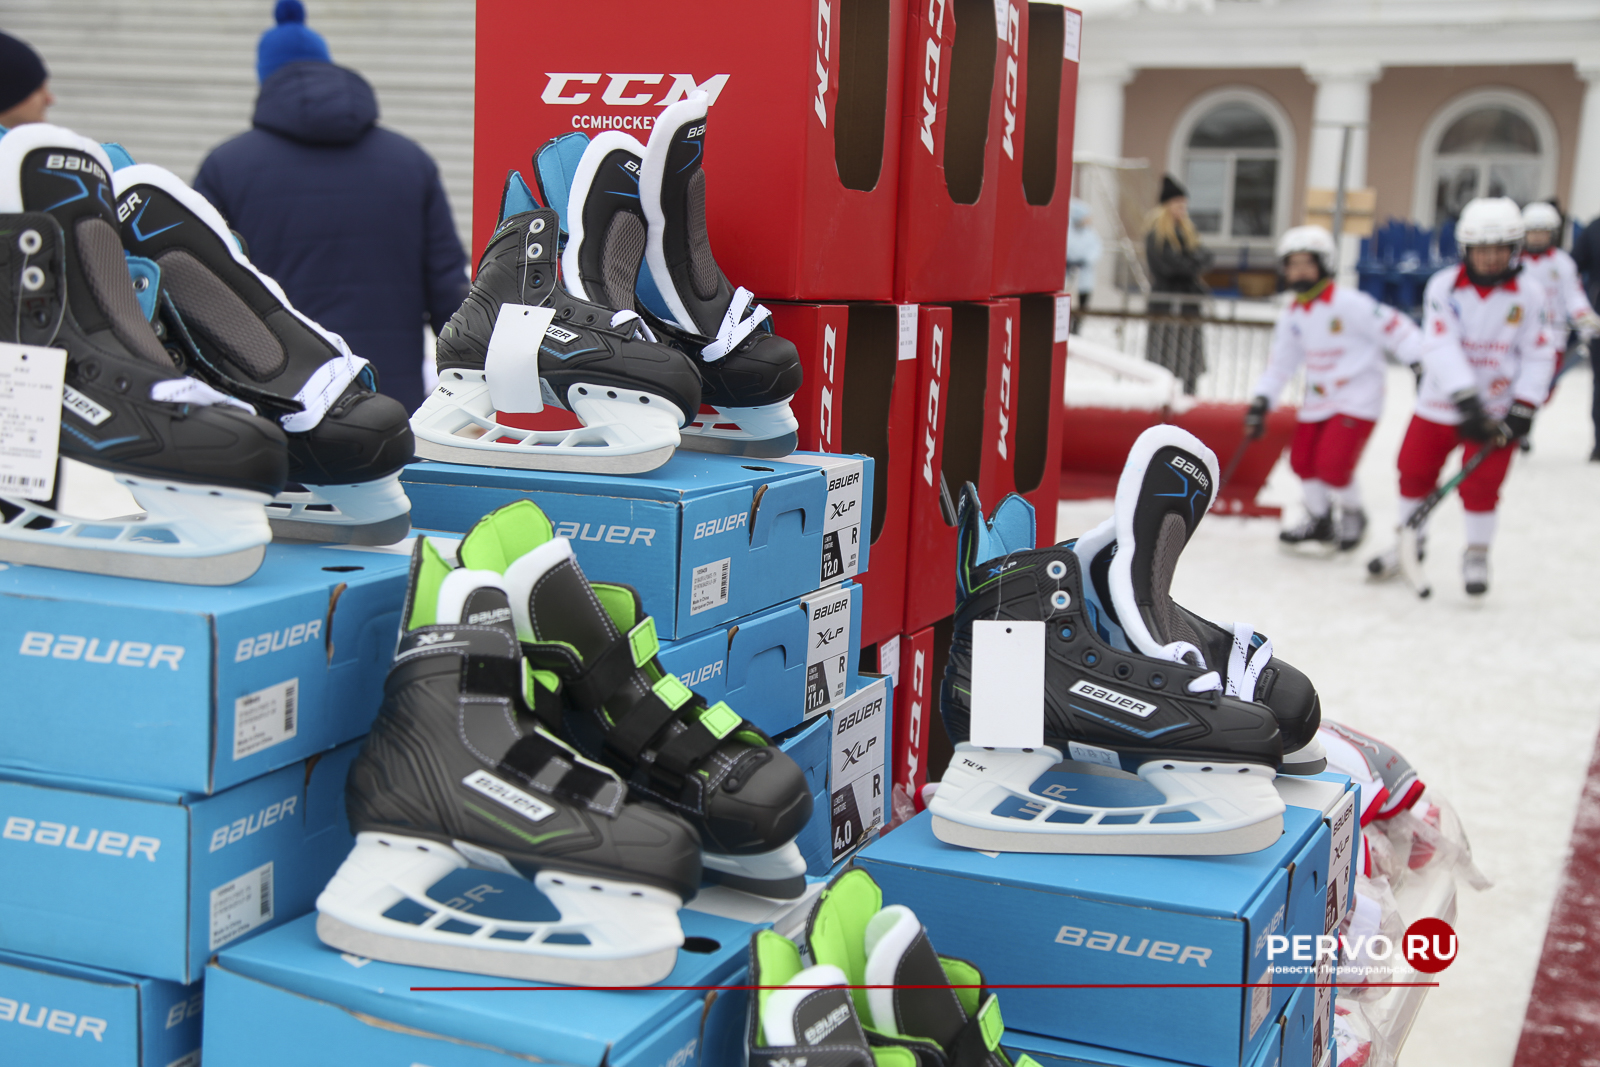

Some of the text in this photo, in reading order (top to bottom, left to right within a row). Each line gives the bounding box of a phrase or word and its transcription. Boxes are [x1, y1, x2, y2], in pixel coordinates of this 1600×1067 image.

[541, 72, 731, 106] CCM
[1003, 3, 1020, 160] CCM
[819, 323, 837, 453] CC
[923, 323, 943, 487] CCM
[828, 472, 860, 492] BAUER
[1170, 455, 1210, 491] BAUER
[693, 512, 748, 540] BAUER
[830, 500, 856, 520] XLP
[551, 520, 656, 546] AUER
[851, 526, 858, 544] R
[823, 558, 839, 578] 12.0
[987, 560, 1018, 578] XLP
[813, 599, 848, 621] BAUER
[19, 630, 185, 671] BAUER
[234, 618, 323, 664] BAUER
[816, 627, 844, 649] XLP
[677, 659, 724, 688] AUER
[838, 655, 846, 674] R
[807, 688, 824, 710] 11.0
[1079, 684, 1147, 713] BAUER
[836, 697, 883, 736] BAUER
[905, 649, 925, 800] CCM
[840, 736, 877, 772] XLP
[474, 777, 542, 815] BAUER
[872, 773, 881, 798] R
[208, 795, 298, 853] BAUER
[833, 819, 852, 850] 4.0
[1333, 803, 1354, 838] BAUER
[2, 815, 161, 862] BAUER
[1333, 834, 1350, 866] XLP
[1053, 925, 1214, 968] BAUER
[1254, 903, 1286, 959] BAUER
